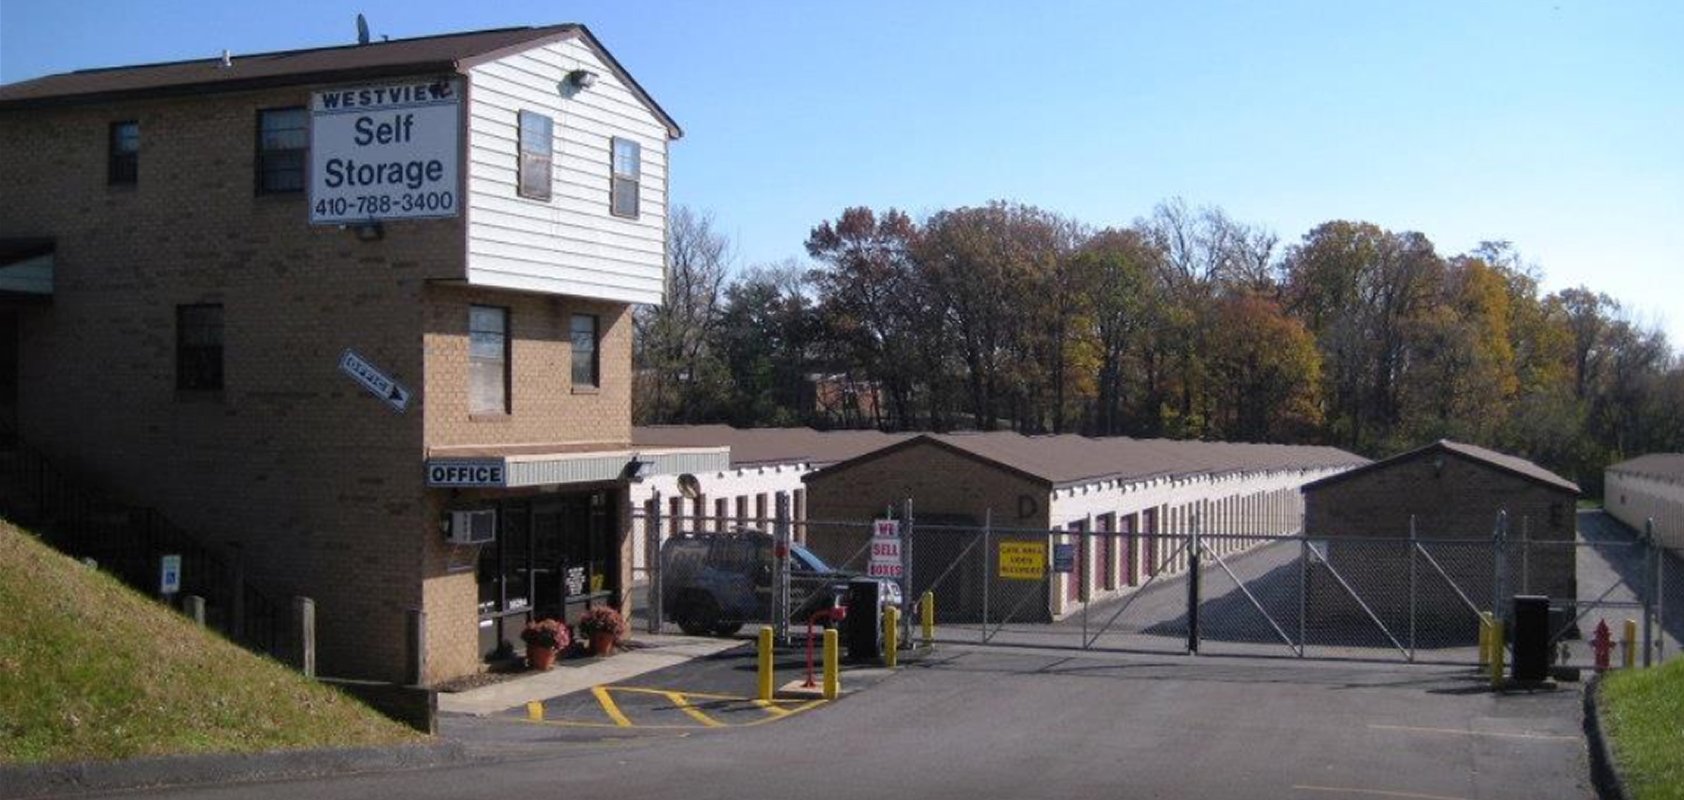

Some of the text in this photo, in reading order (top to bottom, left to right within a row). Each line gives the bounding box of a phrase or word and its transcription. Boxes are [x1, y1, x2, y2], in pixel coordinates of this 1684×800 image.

[354, 114, 414, 146] Self
[324, 158, 443, 189] Storage
[315, 191, 452, 216] 410-788-3400
[432, 467, 501, 482] OFFICE
[879, 523, 894, 535] WE
[873, 544, 898, 555] SELL
